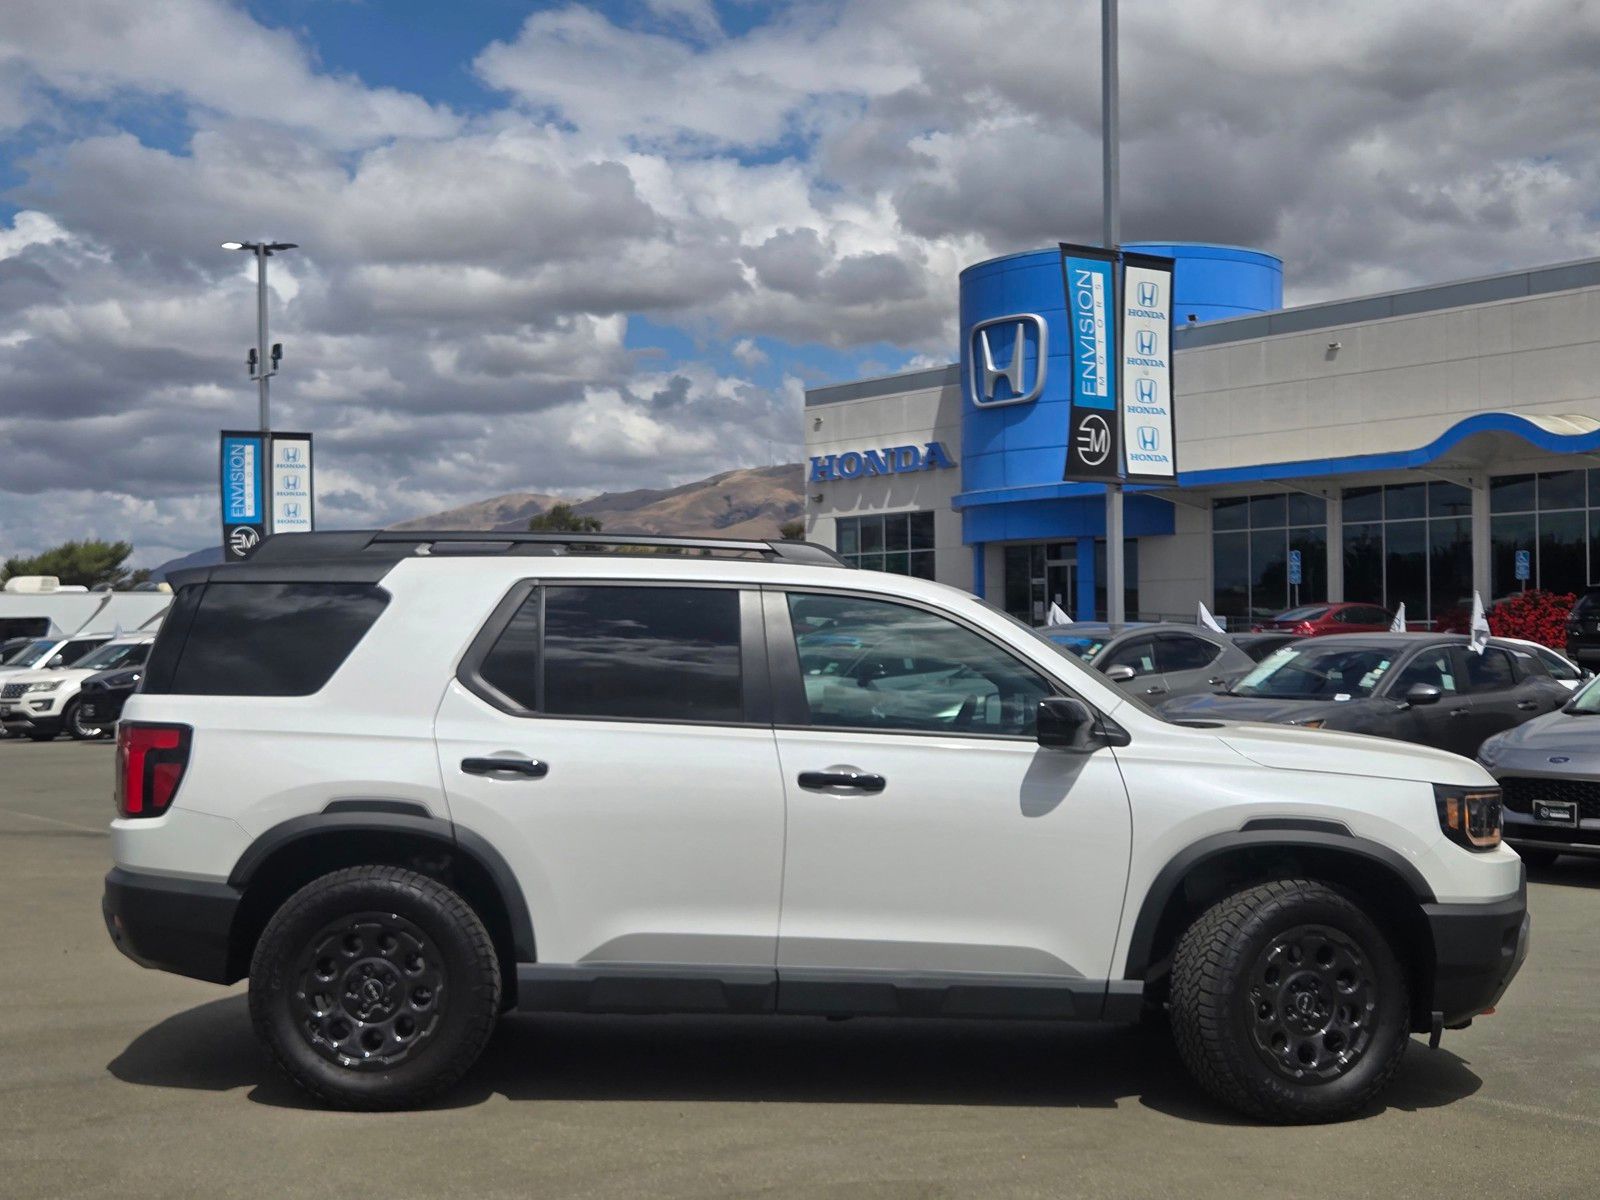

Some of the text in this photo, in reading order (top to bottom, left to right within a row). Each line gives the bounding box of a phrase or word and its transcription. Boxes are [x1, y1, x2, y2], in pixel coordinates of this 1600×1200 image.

[1128, 308, 1166, 320] HONDA
[1075, 269, 1097, 396] ENVISION
[1096, 283, 1105, 386] MOTORS
[1127, 357, 1165, 368] HONDA
[1127, 405, 1167, 415] HONDA
[809, 441, 956, 482] HONDA
[1130, 453, 1169, 463] HONDA
[230, 444, 245, 517] ENVISION
